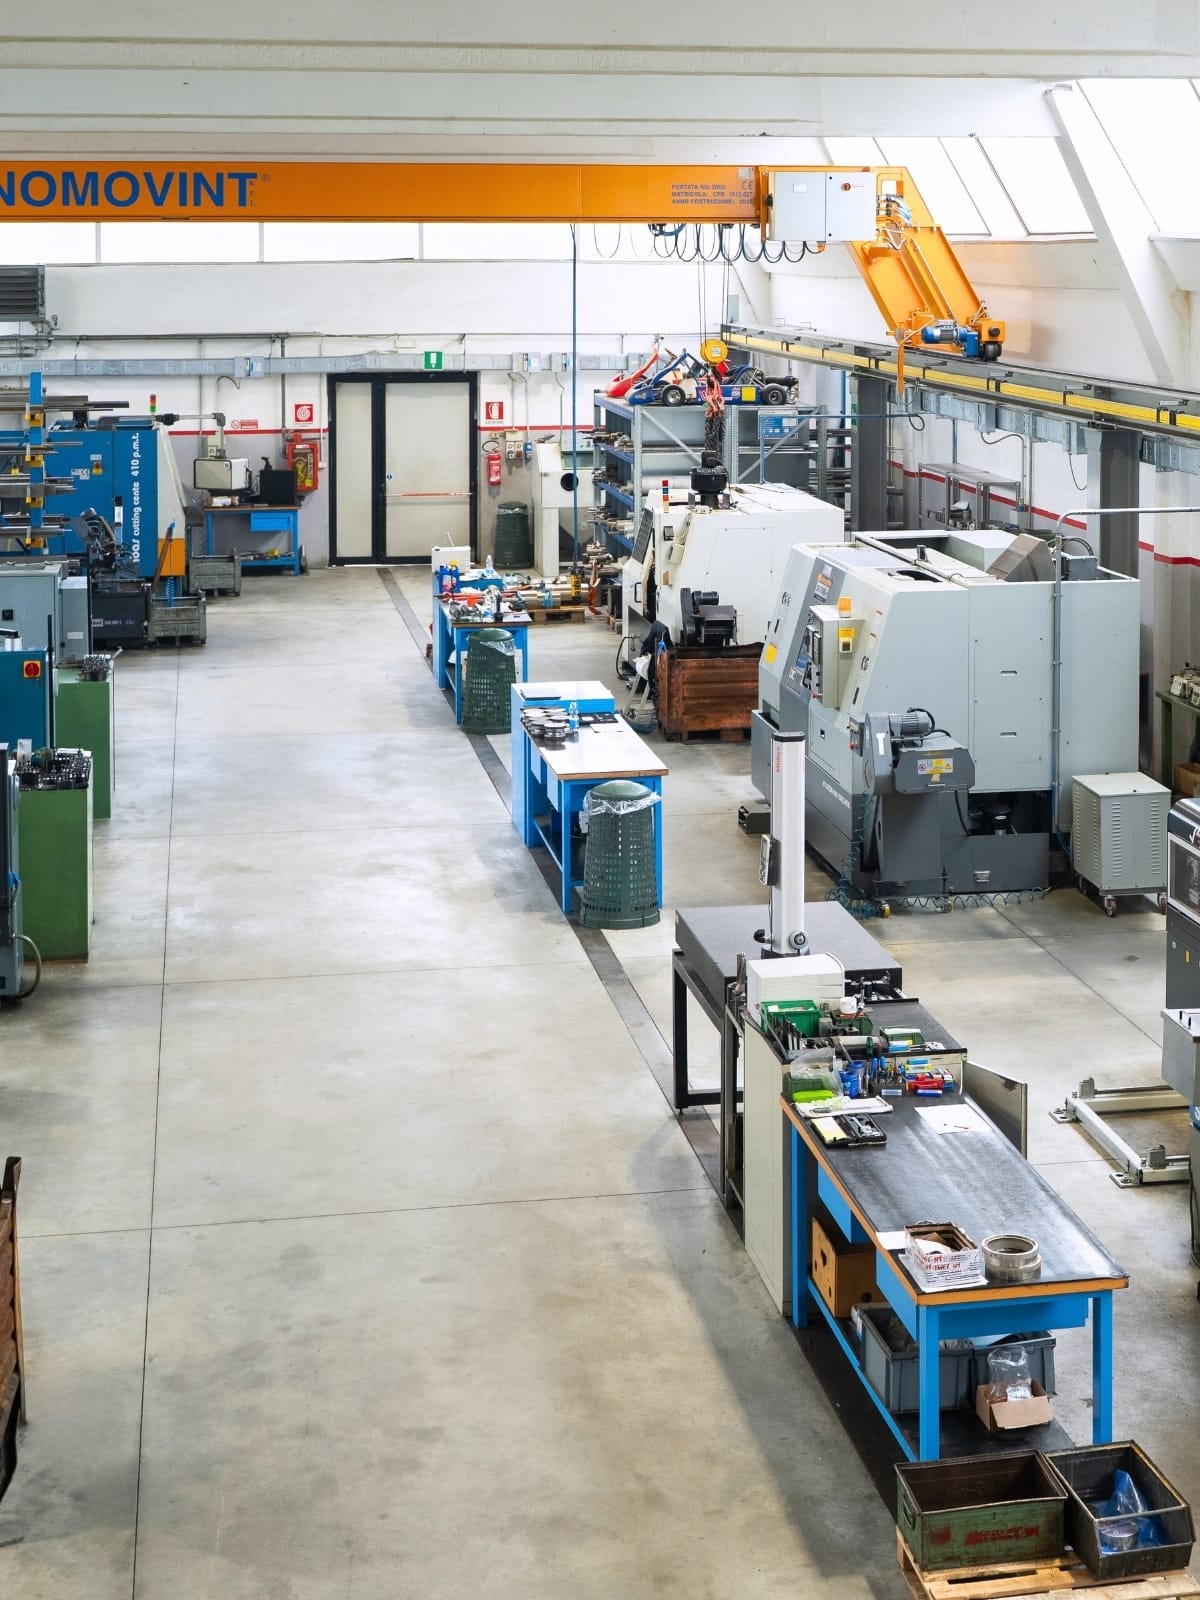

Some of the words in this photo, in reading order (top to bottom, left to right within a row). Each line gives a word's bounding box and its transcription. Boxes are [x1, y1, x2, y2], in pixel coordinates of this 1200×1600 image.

[131, 432, 142, 458] p.m.t.
[130, 459, 140, 477] 410
[131, 506, 142, 537] cutting
